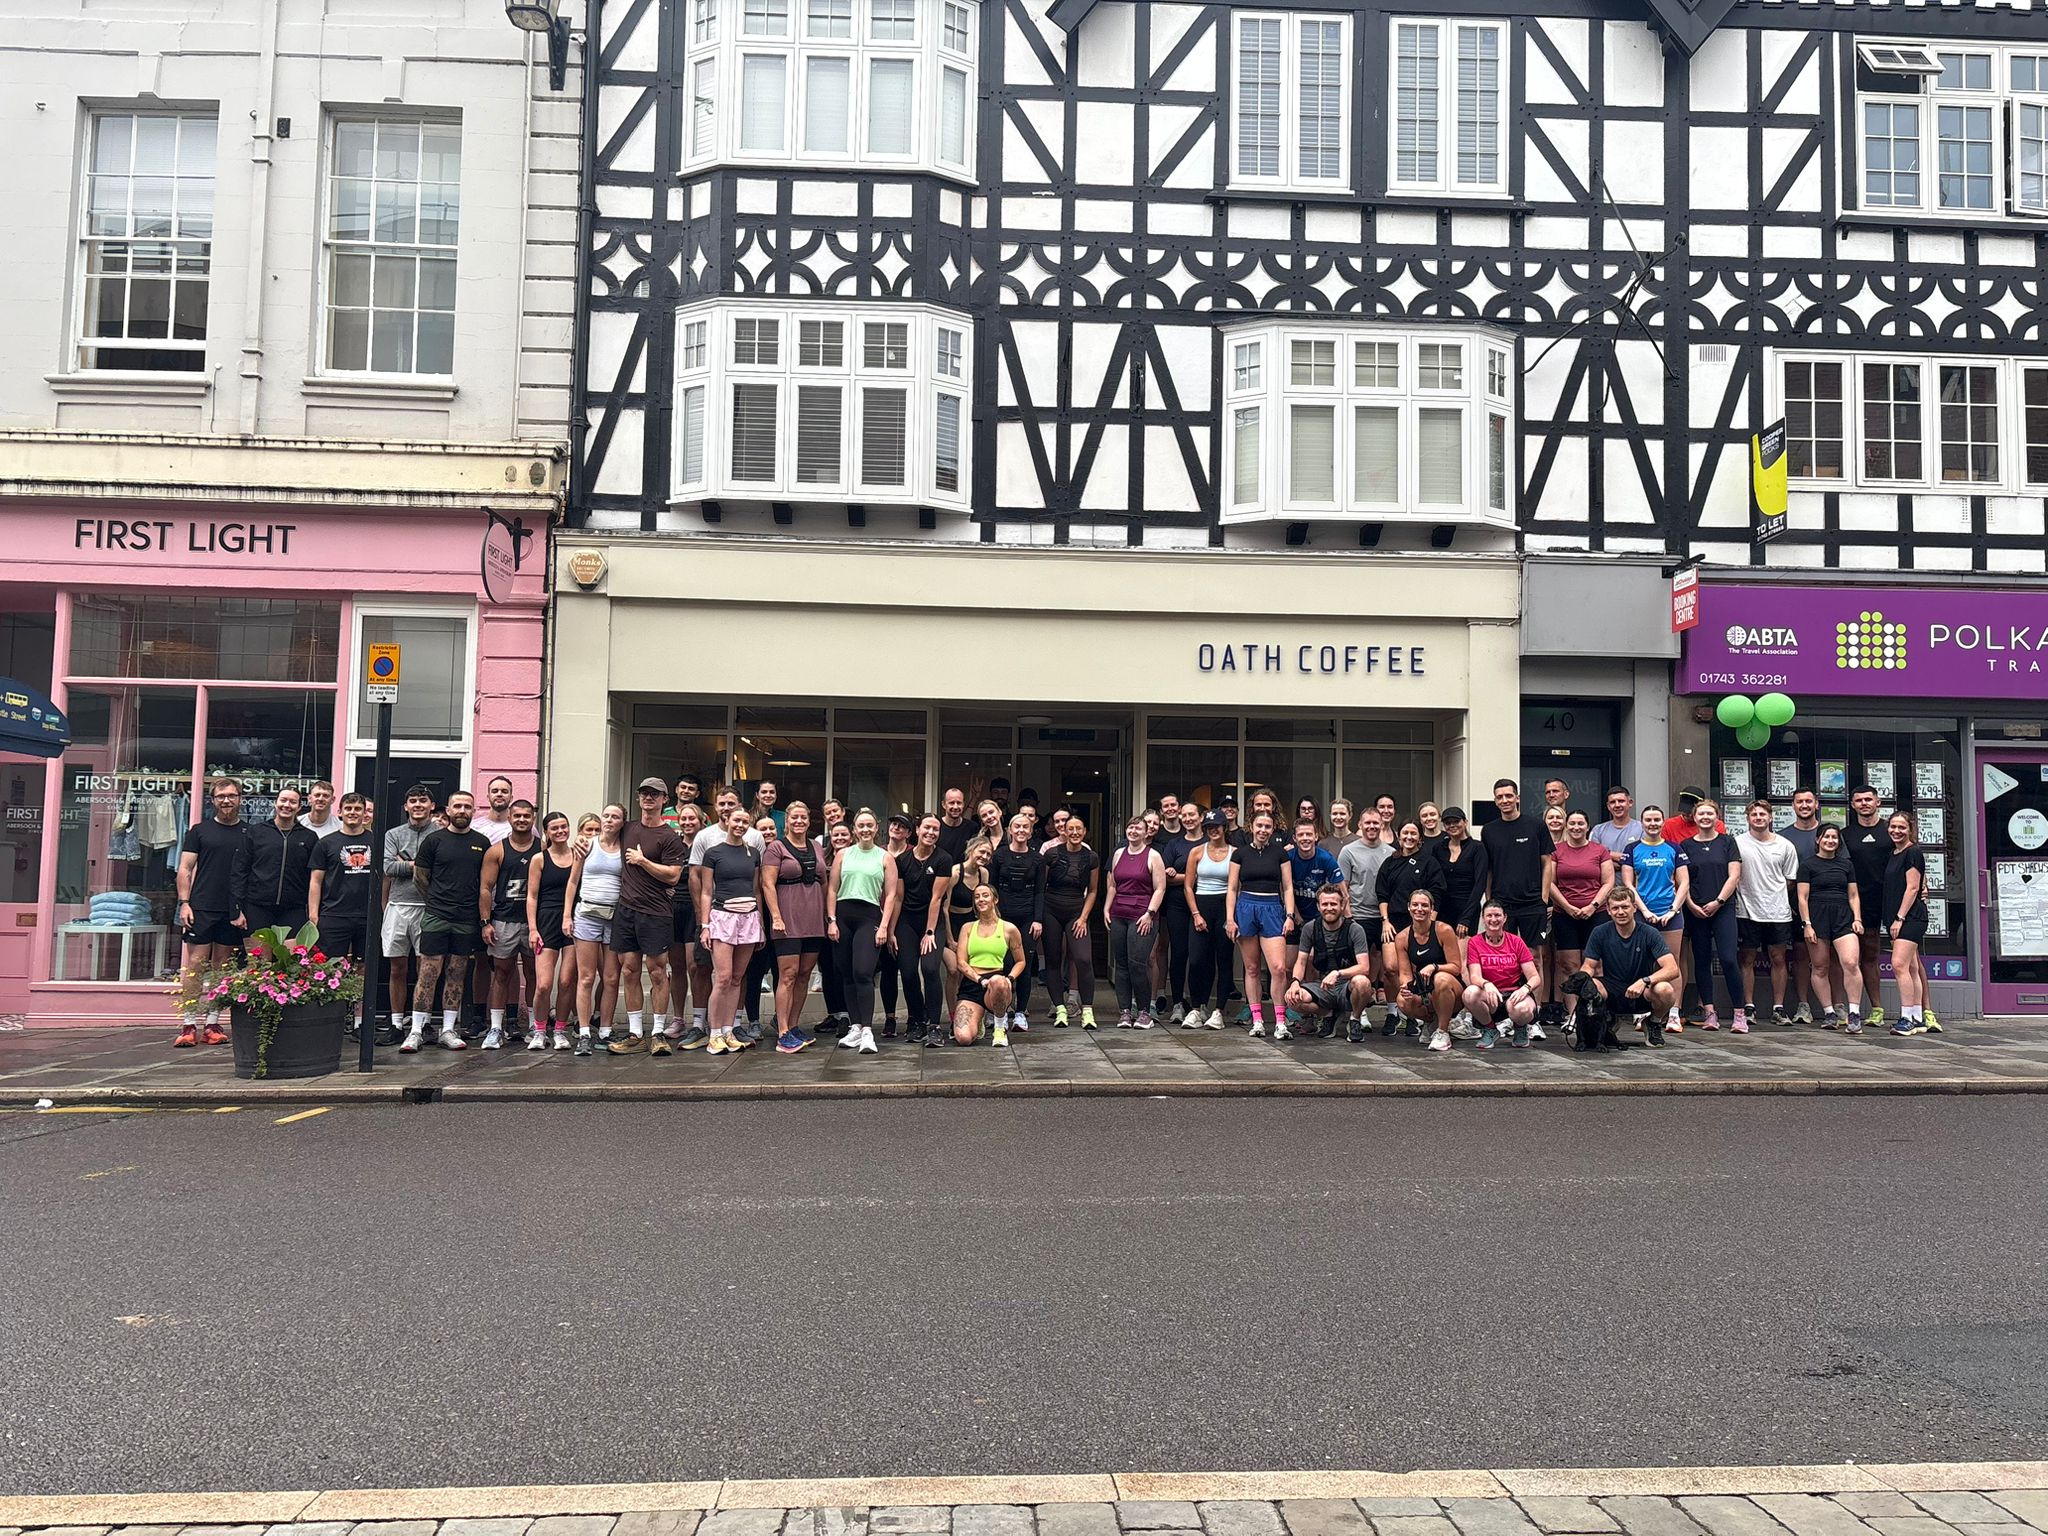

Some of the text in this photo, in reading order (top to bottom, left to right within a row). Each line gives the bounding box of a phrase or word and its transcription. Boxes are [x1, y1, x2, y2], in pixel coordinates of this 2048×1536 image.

[1761, 427, 1784, 444] COOPER
[1761, 436, 1780, 451] GREEN
[1756, 515, 1785, 536] TO LET
[75, 519, 297, 554] FIRST LIGHT
[487, 544, 513, 568] FIRST LIGHT
[1673, 590, 1697, 611] BOOKING
[1675, 605, 1695, 625] CENTRE
[1746, 628, 1798, 647] ABTA
[1930, 624, 2048, 651] POLKA
[1198, 643, 1425, 674] OATH COFFEE
[1986, 659, 2041, 673] TRA
[1699, 673, 1787, 685] 01743 362281
[10, 710, 27, 722] Street
[1543, 712, 1575, 731] 40
[75, 775, 179, 792] FIRST LIGHT
[74, 796, 116, 804] ABERSOCH
[6, 808, 40, 819] FIRST
